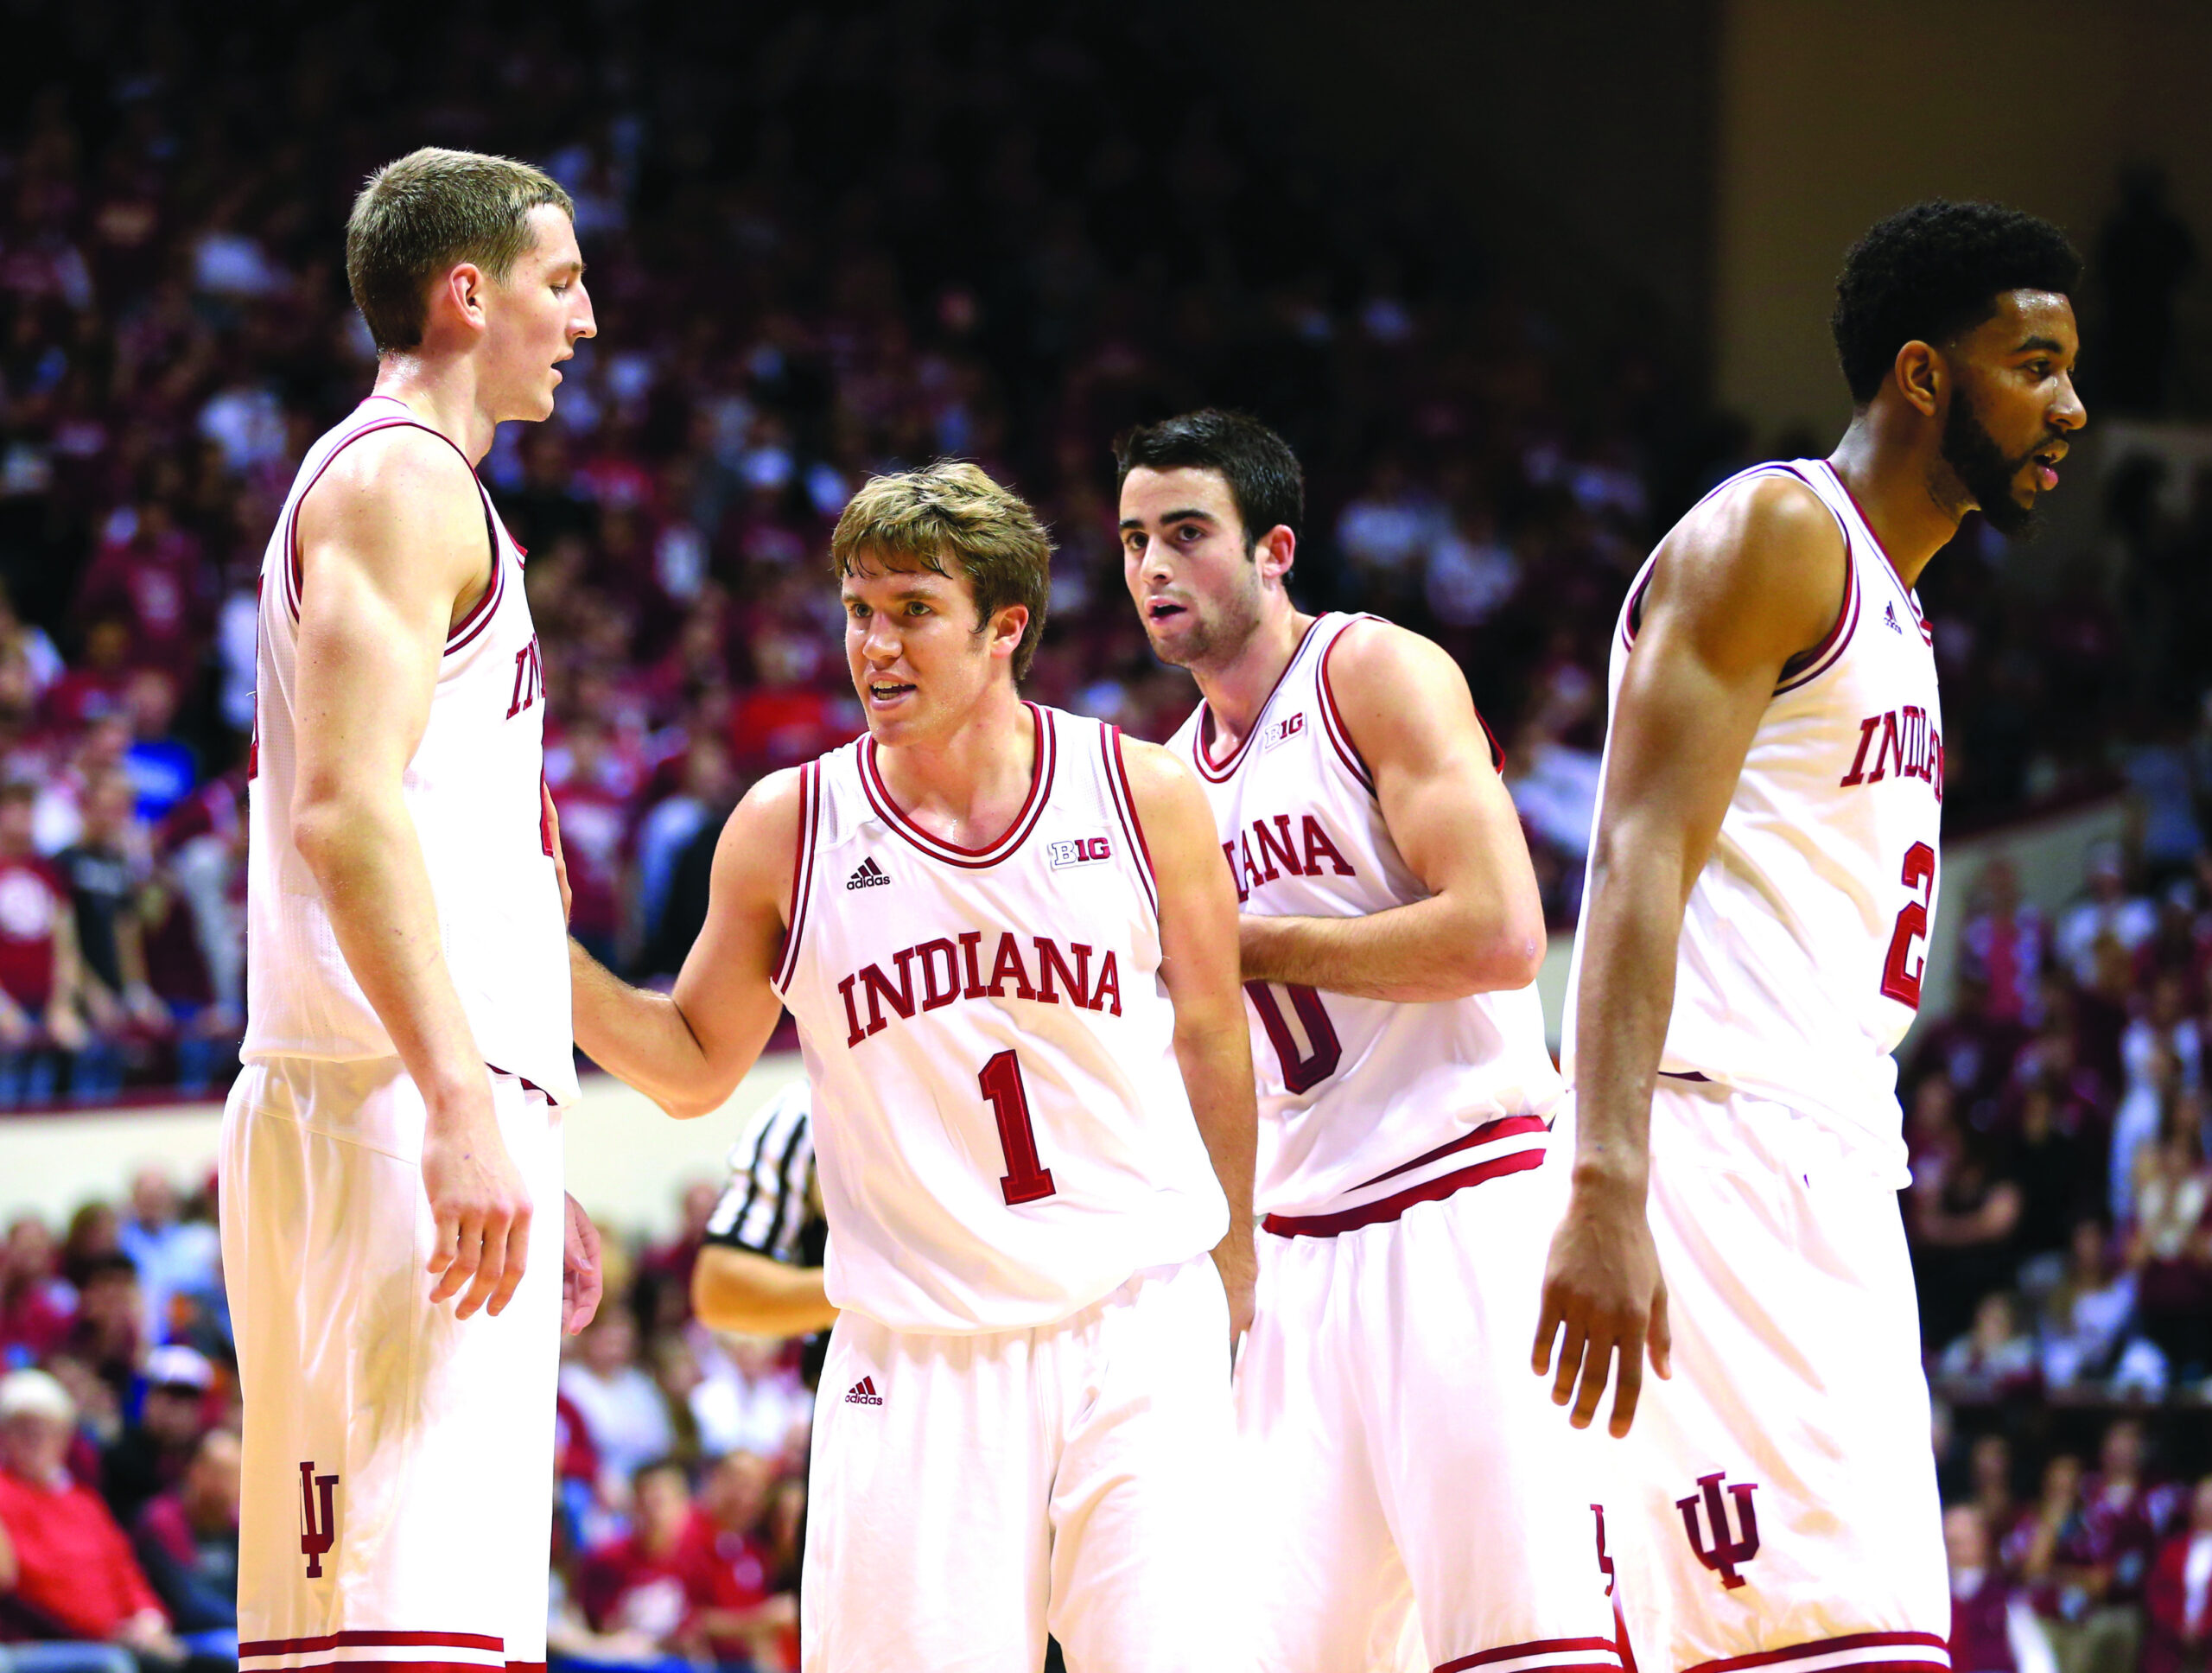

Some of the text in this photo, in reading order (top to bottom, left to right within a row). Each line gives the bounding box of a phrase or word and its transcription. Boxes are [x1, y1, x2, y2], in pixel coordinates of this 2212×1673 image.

[846, 875, 891, 890] adidas
[1880, 841, 1936, 1011] 2
[838, 932, 1122, 1048] INDIANA
[978, 1049, 1057, 1205] 1
[845, 1393, 883, 1406] adidas
